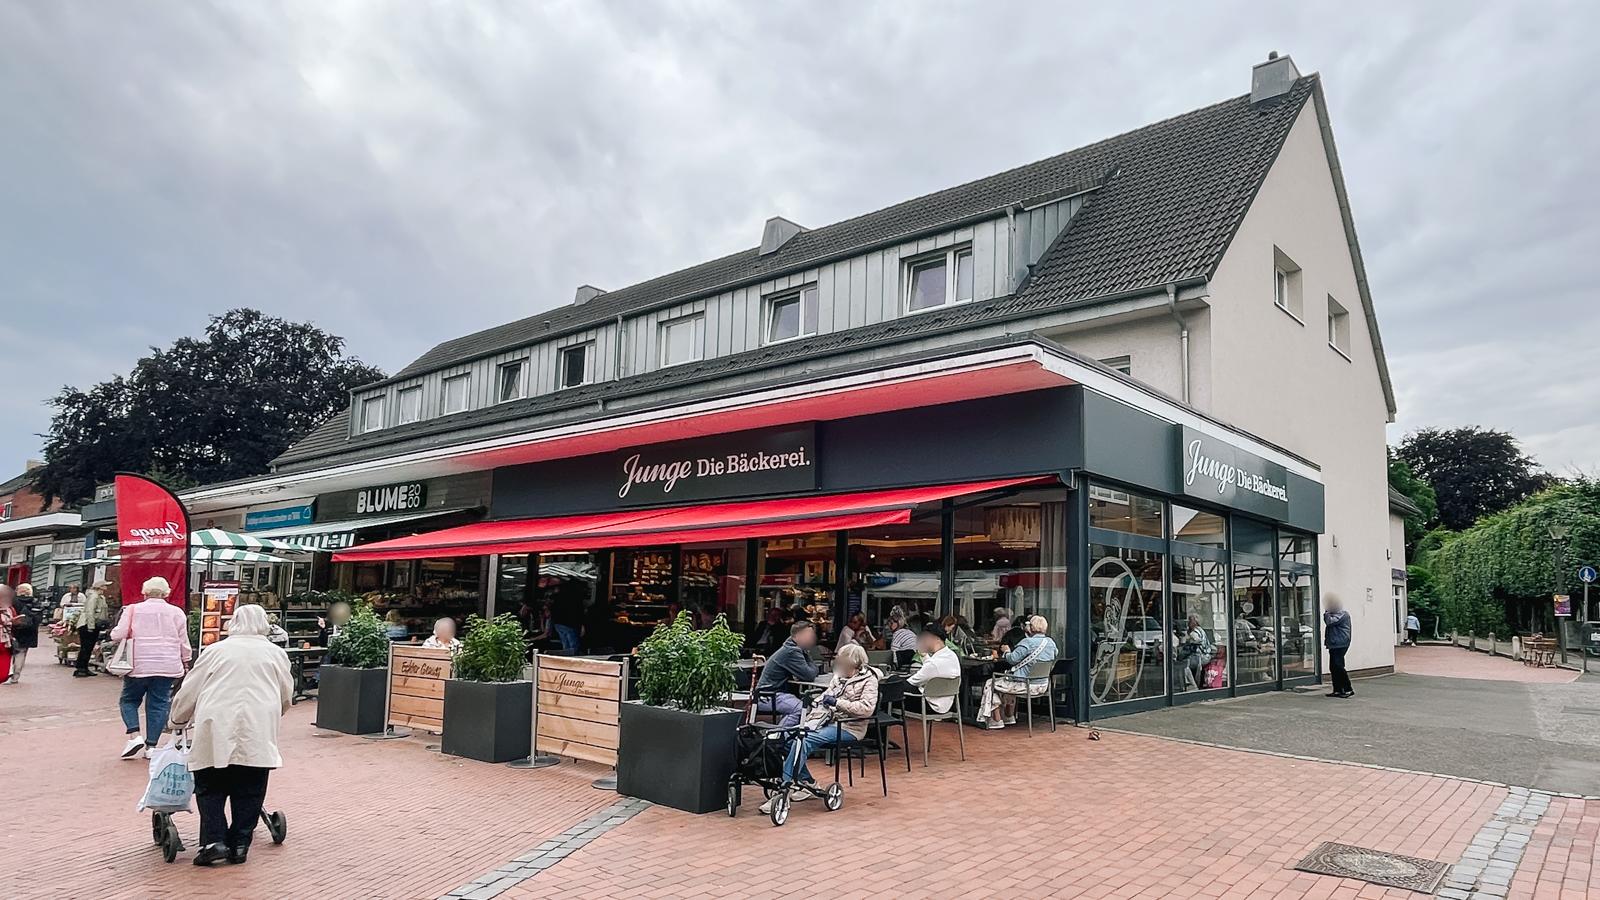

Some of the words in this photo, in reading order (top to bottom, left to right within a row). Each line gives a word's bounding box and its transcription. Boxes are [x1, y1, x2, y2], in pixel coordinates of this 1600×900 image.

[618, 454, 692, 498] Junge
[697, 458, 725, 478] Die
[726, 447, 811, 474] Bäckerei.
[1186, 439, 1236, 494] Junge
[1236, 468, 1253, 491] Die
[1251, 474, 1289, 502] Bäckerei.
[356, 485, 408, 514] BLUME
